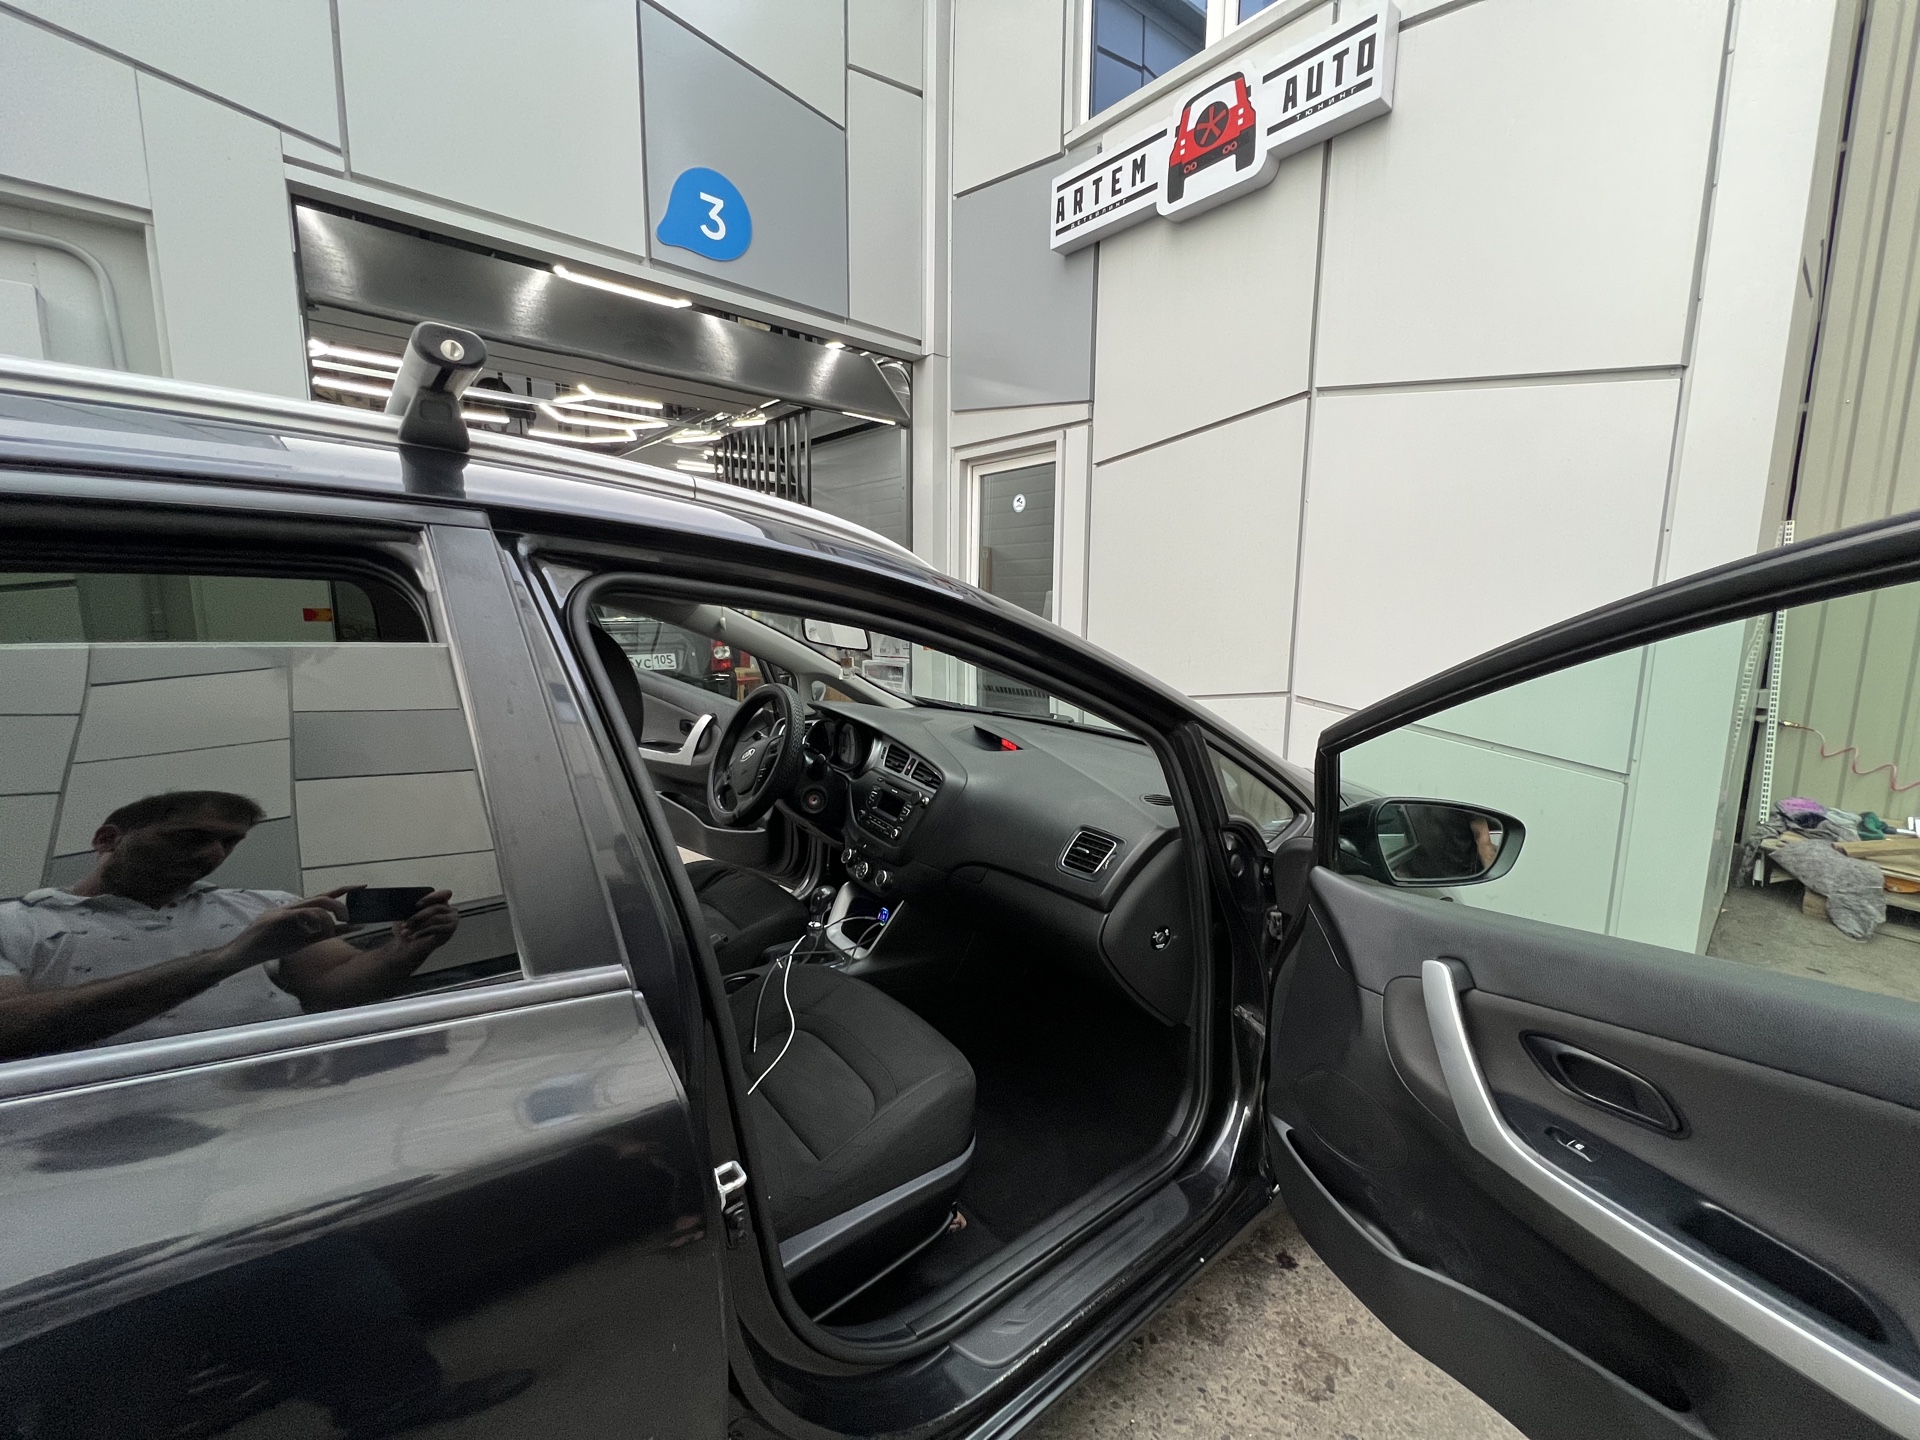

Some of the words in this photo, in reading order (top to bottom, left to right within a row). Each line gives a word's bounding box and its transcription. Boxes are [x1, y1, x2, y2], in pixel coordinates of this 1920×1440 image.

[1295, 86, 1357, 121] ТЮНИНГ
[1055, 152, 1147, 225] ARTEM
[1282, 32, 1377, 114] AUTO
[699, 191, 727, 241] 3
[653, 654, 675, 666] 105
